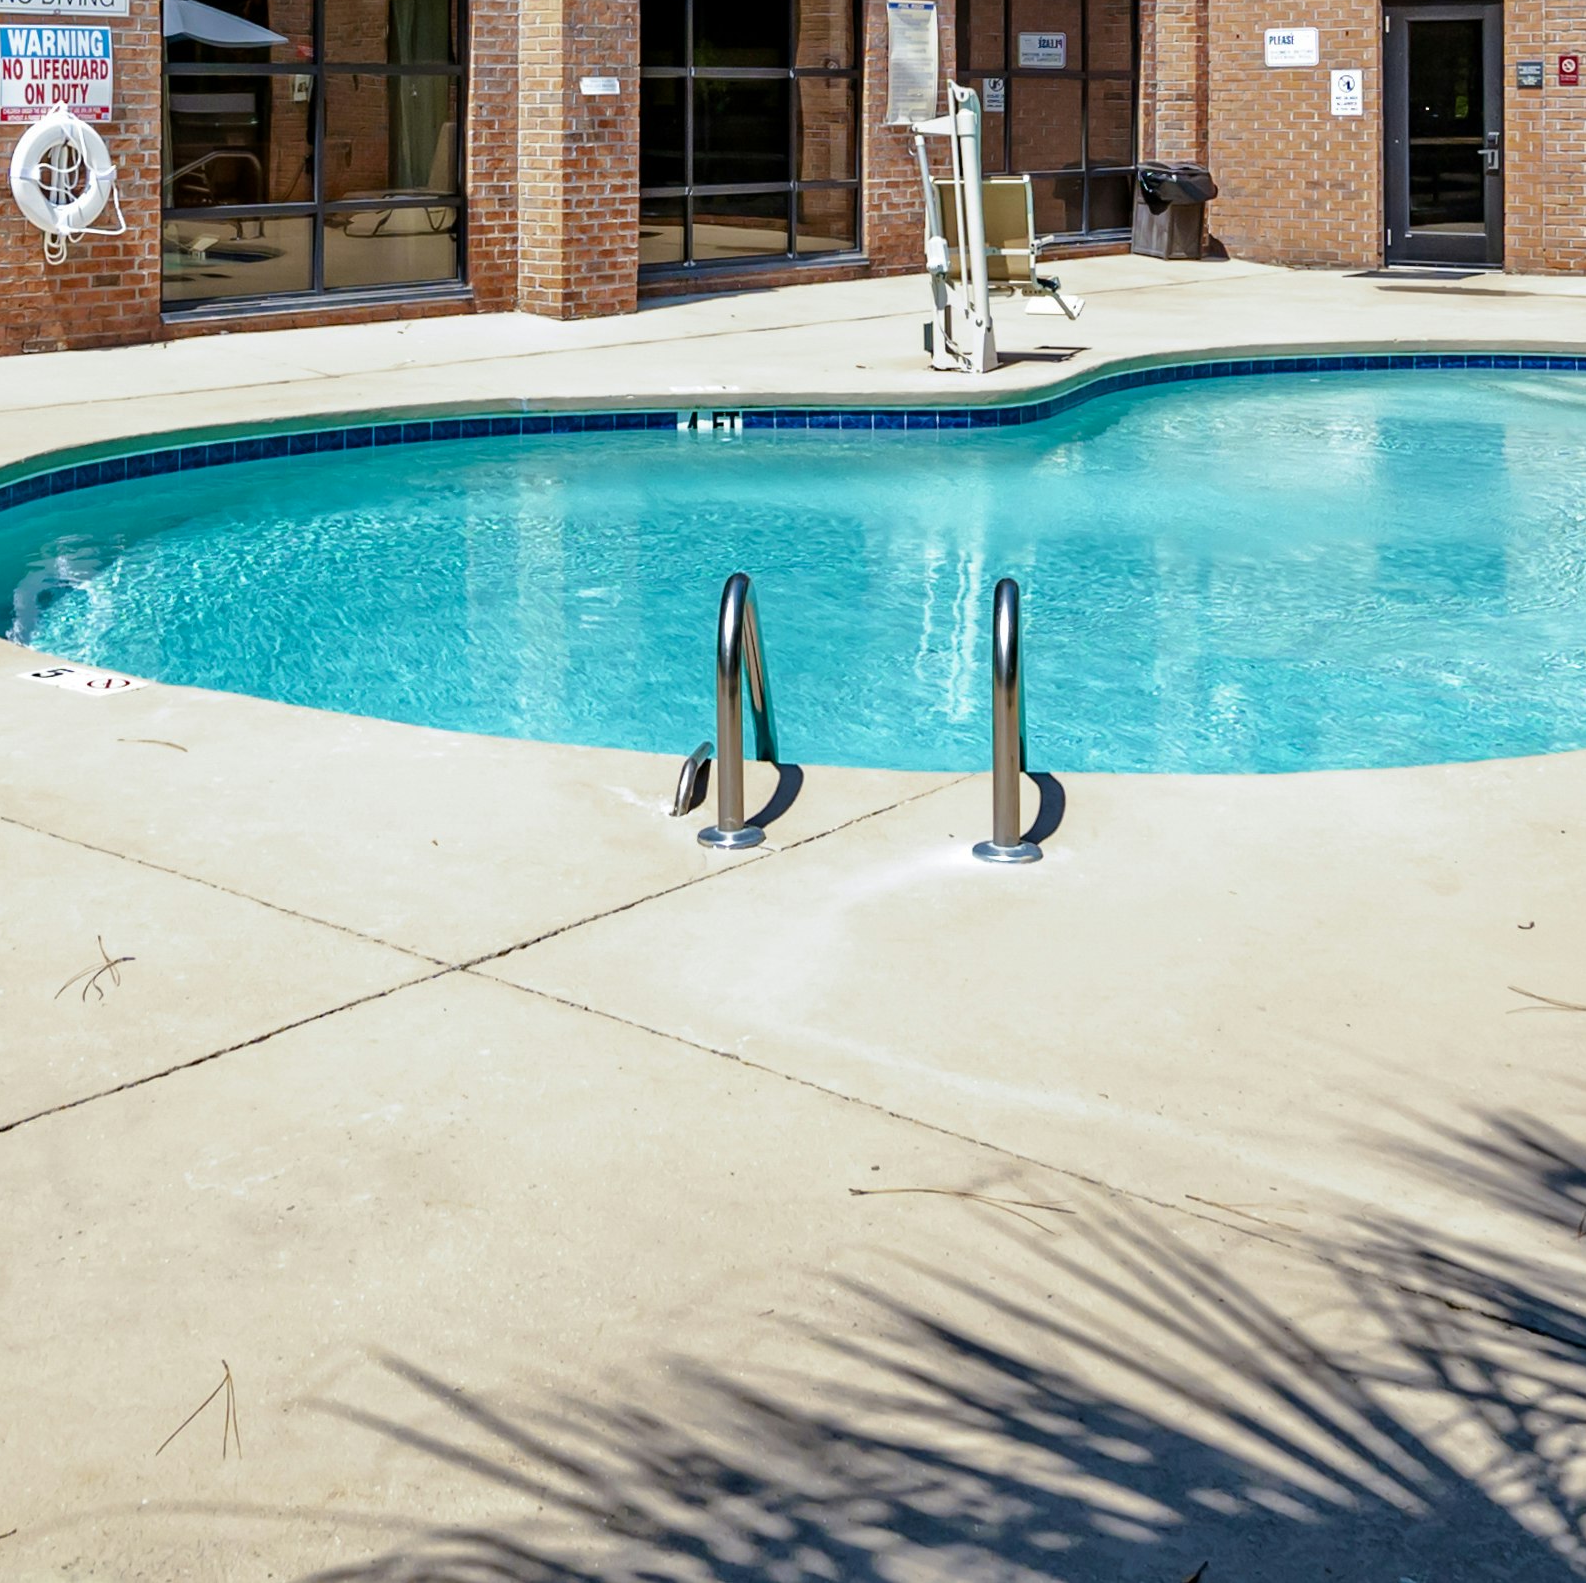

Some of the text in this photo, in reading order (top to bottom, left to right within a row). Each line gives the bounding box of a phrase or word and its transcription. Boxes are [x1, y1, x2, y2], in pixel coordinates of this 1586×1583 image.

[7, 29, 104, 57] WARNING
[2, 59, 108, 80] NO LIFEGUARD
[25, 83, 89, 105] ON DUTY
